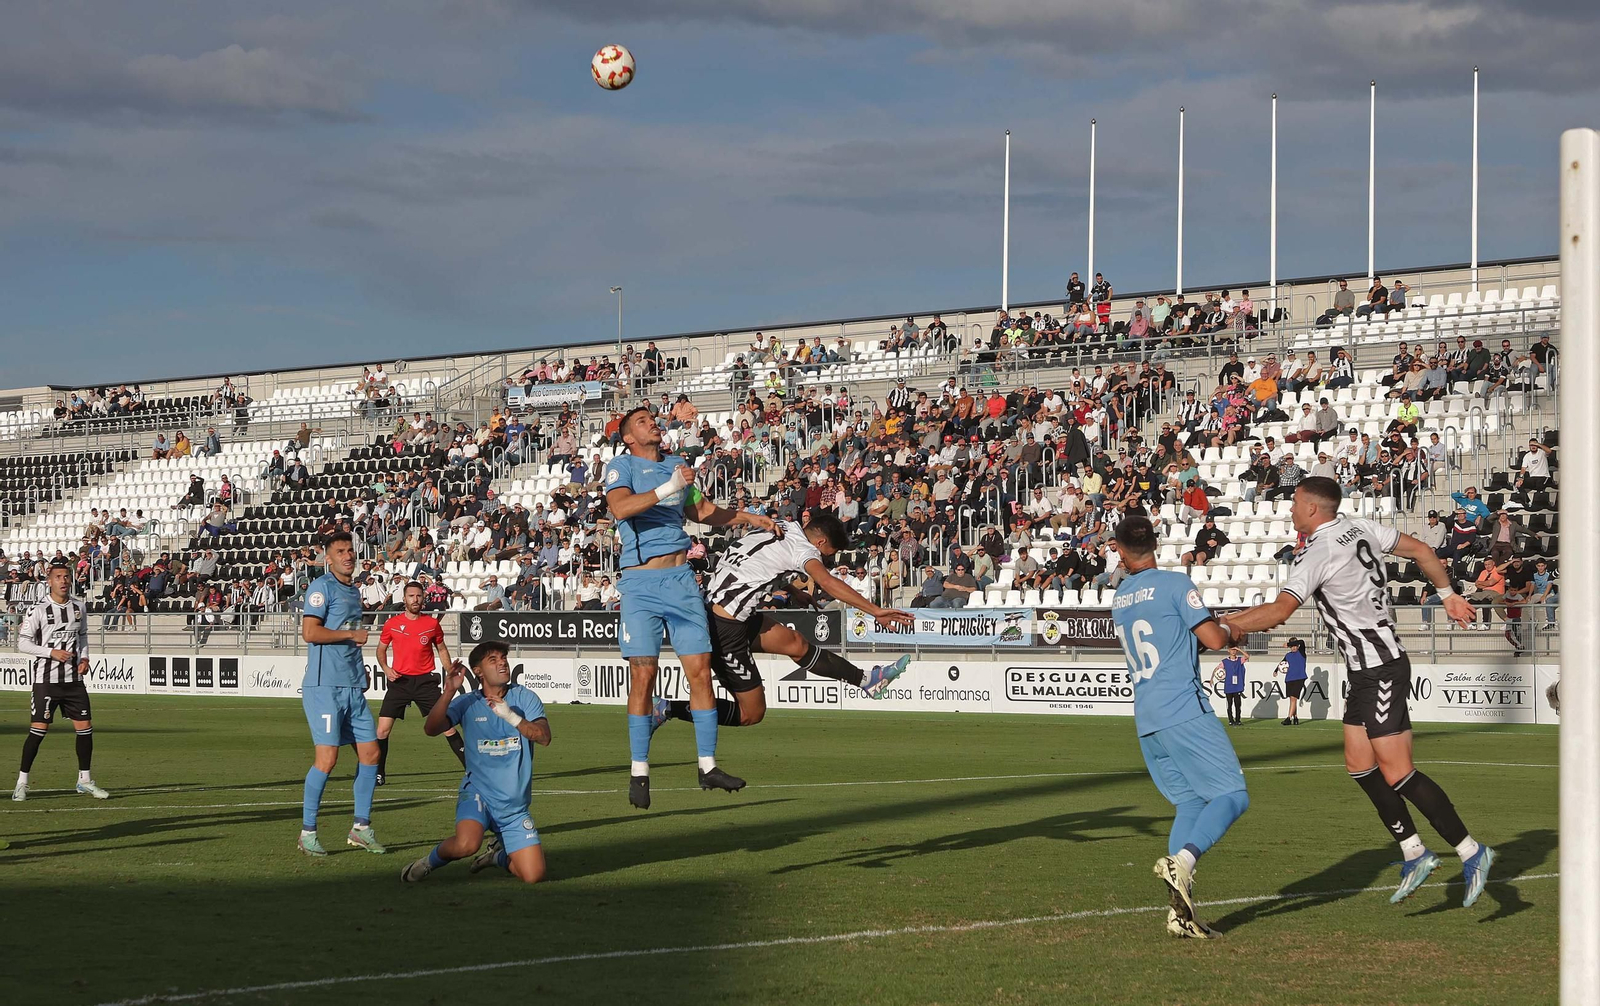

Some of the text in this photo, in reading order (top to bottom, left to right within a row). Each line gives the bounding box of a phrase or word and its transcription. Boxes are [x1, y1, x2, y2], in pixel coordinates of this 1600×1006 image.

[1356, 538, 1386, 588] 9
[1112, 586, 1156, 610] ERGIO DÍAZ
[498, 618, 619, 639] Somos La Reci
[921, 620, 936, 632] 1912
[940, 614, 998, 637] PICHIGÜEY
[1066, 617, 1117, 640] BALONA
[1116, 619, 1160, 684] 16
[0, 659, 32, 685] mal
[88, 658, 135, 682] Velada
[247, 669, 292, 689] Mesón de
[266, 665, 275, 677] el
[524, 673, 552, 681] Marbella
[1010, 672, 1132, 684] DESGUACES
[1444, 672, 1523, 685] Salón de Belleza
[524, 681, 572, 690] Football Center
[777, 685, 838, 704] LOTUS
[843, 684, 991, 701] feraansa feralmansa
[1011, 684, 1133, 697] EL MALAGUEÑO
[1201, 680, 1329, 702] SERAA
[43, 696, 52, 710] 7
[1442, 689, 1527, 704] VELVET
[1464, 709, 1506, 717] GUADACORTE
